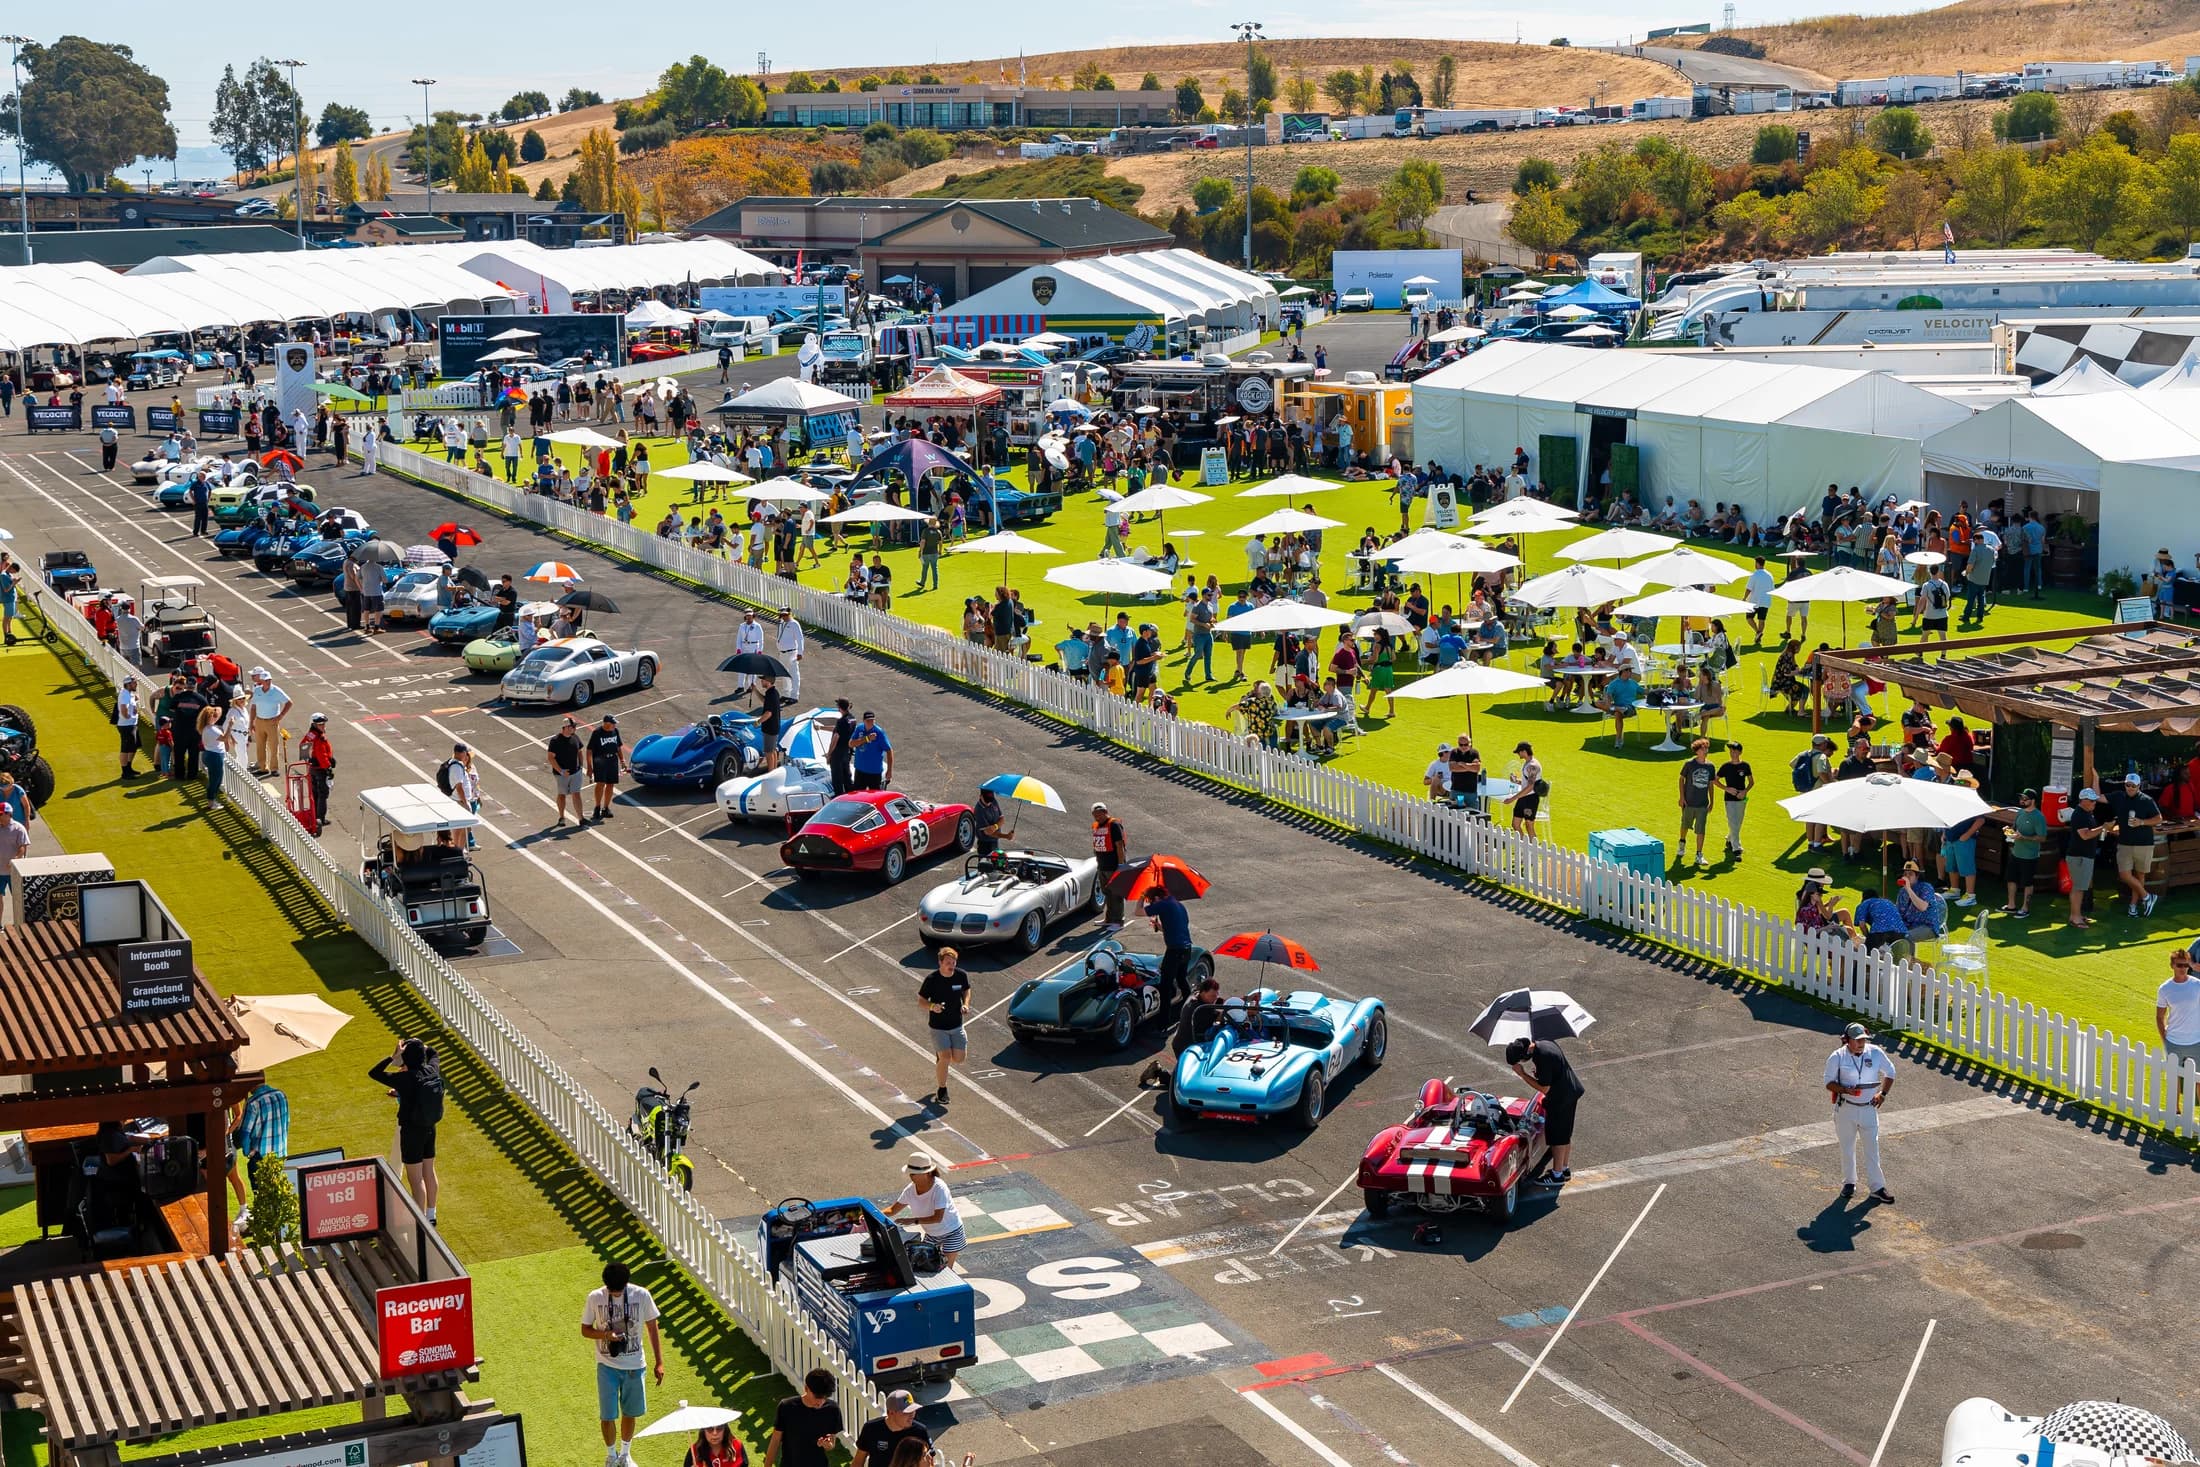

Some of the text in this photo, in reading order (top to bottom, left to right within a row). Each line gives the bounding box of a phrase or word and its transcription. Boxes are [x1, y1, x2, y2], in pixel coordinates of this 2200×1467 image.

[445, 323, 473, 334] Mobil
[1924, 318, 1993, 329] VELOCITY
[1923, 328, 1992, 337] INVITATIONA
[152, 412, 173, 420] VELOCIT
[203, 415, 233, 423] VELOCITY
[1984, 463, 2034, 479] HopMonk
[608, 661, 621, 682] 49
[338, 672, 455, 687] CLEAR
[377, 686, 471, 700] KEEP
[910, 822, 930, 850] 33
[130, 948, 182, 961] Information
[143, 960, 170, 972] Booth
[132, 983, 183, 997] Grandstand
[126, 994, 191, 1009] Suite Check-in
[1226, 1051, 1264, 1065] 64
[1090, 1178, 1315, 1226] CLEAR
[384, 1293, 465, 1318] Raceway
[410, 1316, 442, 1335] Bar
[418, 1343, 453, 1355] SONOMA
[419, 1350, 457, 1364] RACEWAY
